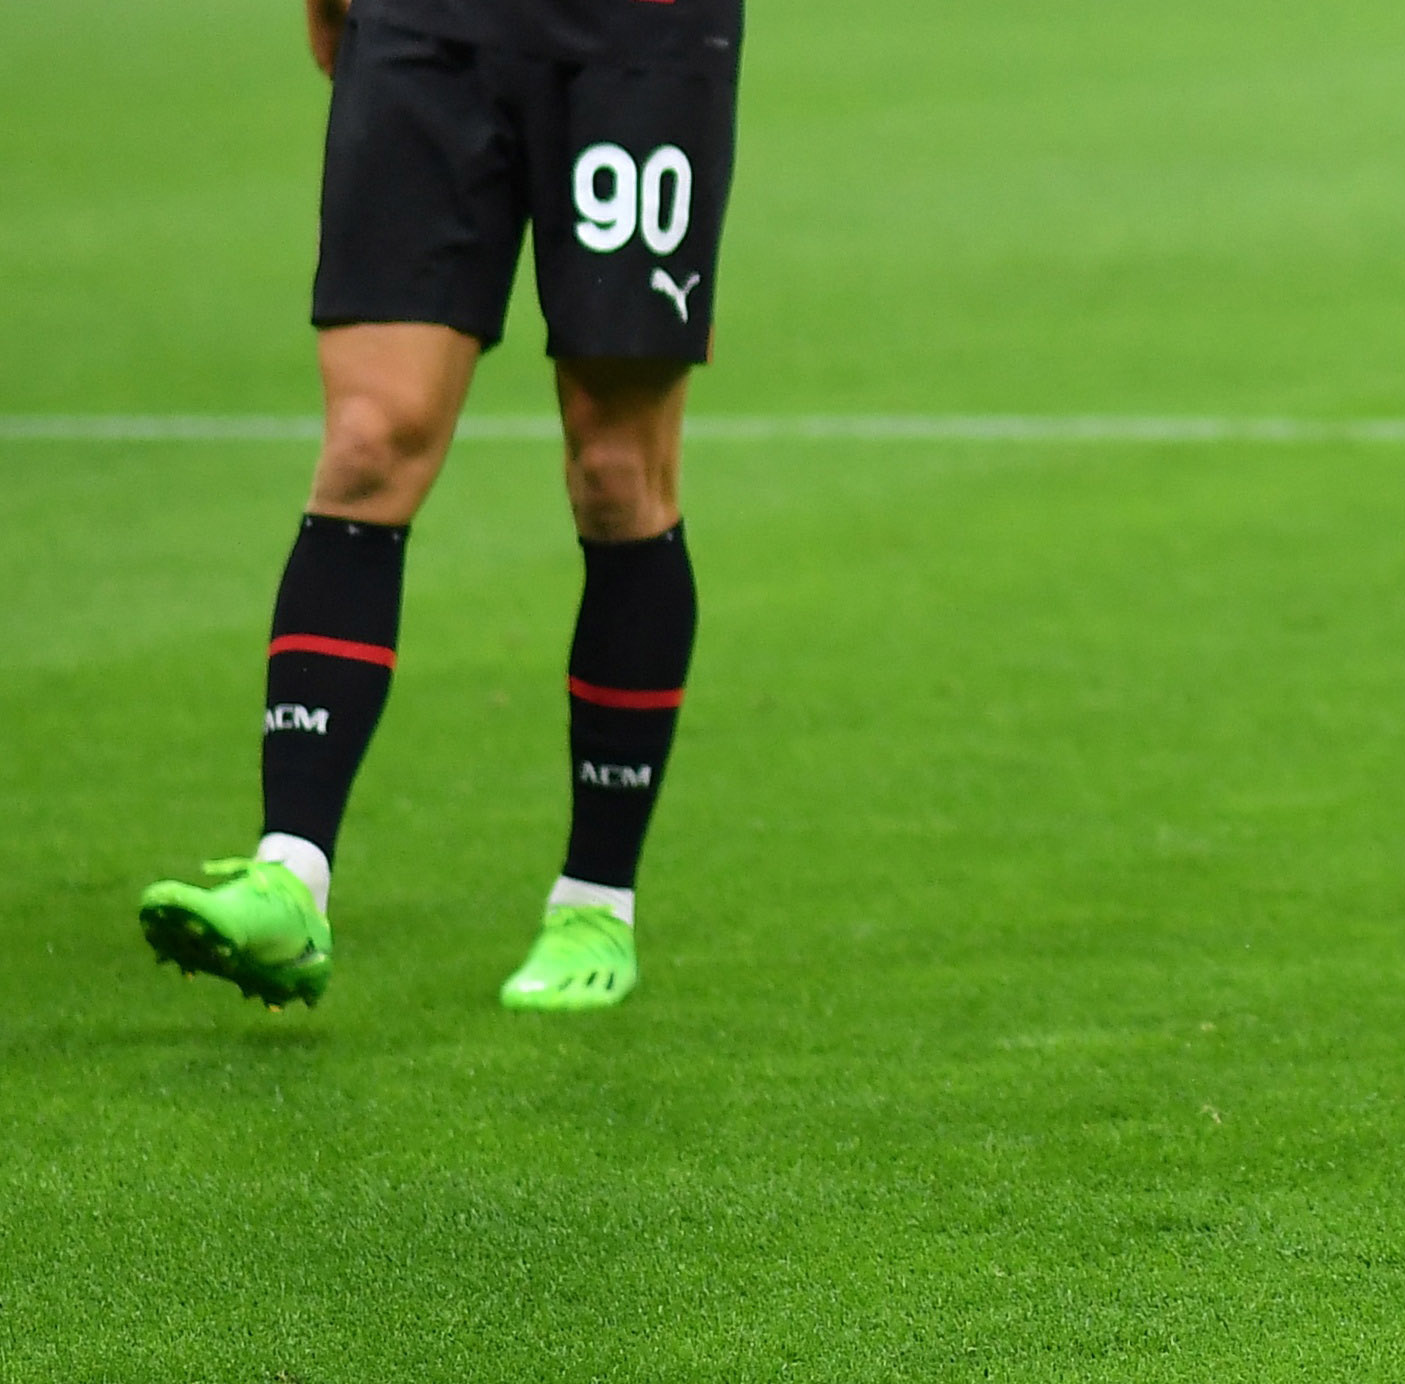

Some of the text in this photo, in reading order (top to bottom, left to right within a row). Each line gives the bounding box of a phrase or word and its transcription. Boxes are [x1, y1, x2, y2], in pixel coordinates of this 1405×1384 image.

[573, 141, 693, 256] 90
[264, 703, 330, 736] ACM
[580, 759, 653, 788] ACM
